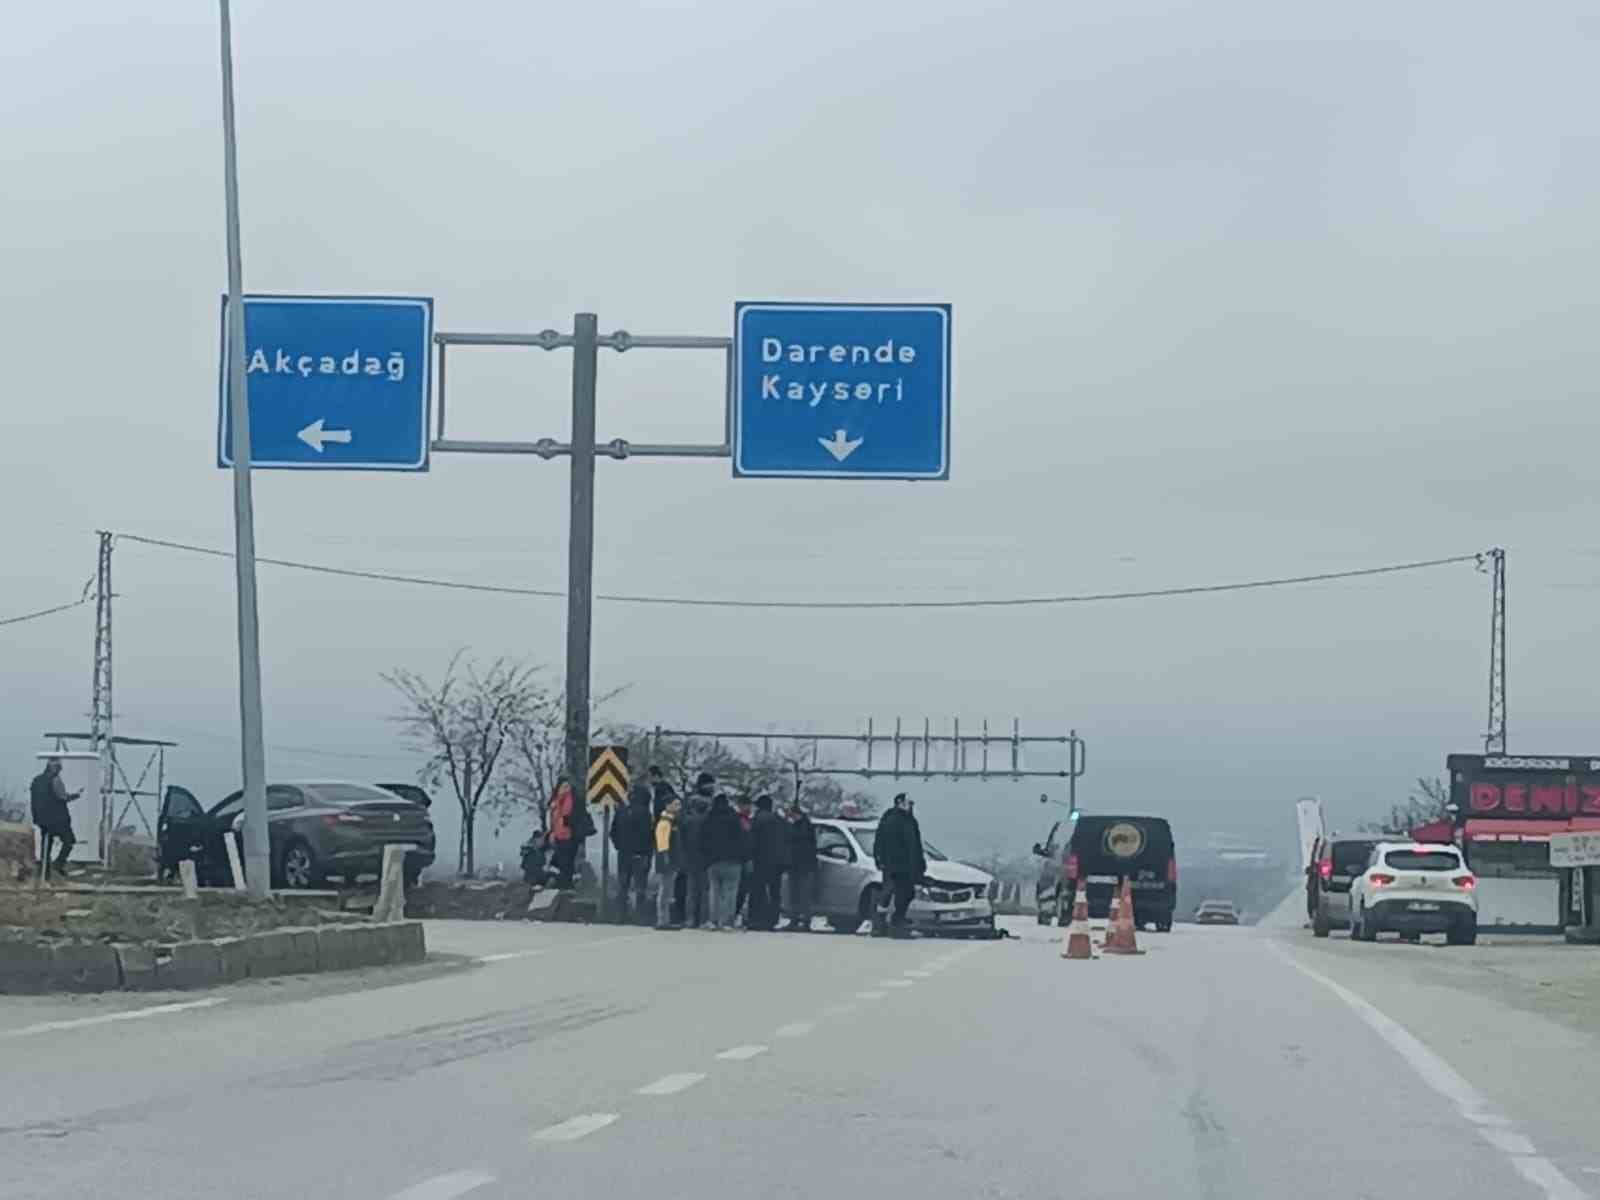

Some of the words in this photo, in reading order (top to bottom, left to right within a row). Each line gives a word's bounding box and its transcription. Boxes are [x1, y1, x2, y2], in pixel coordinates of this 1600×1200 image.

[247, 349, 405, 381] Akçadağ
[762, 338, 916, 363] Darende
[762, 375, 903, 407] Kayseri
